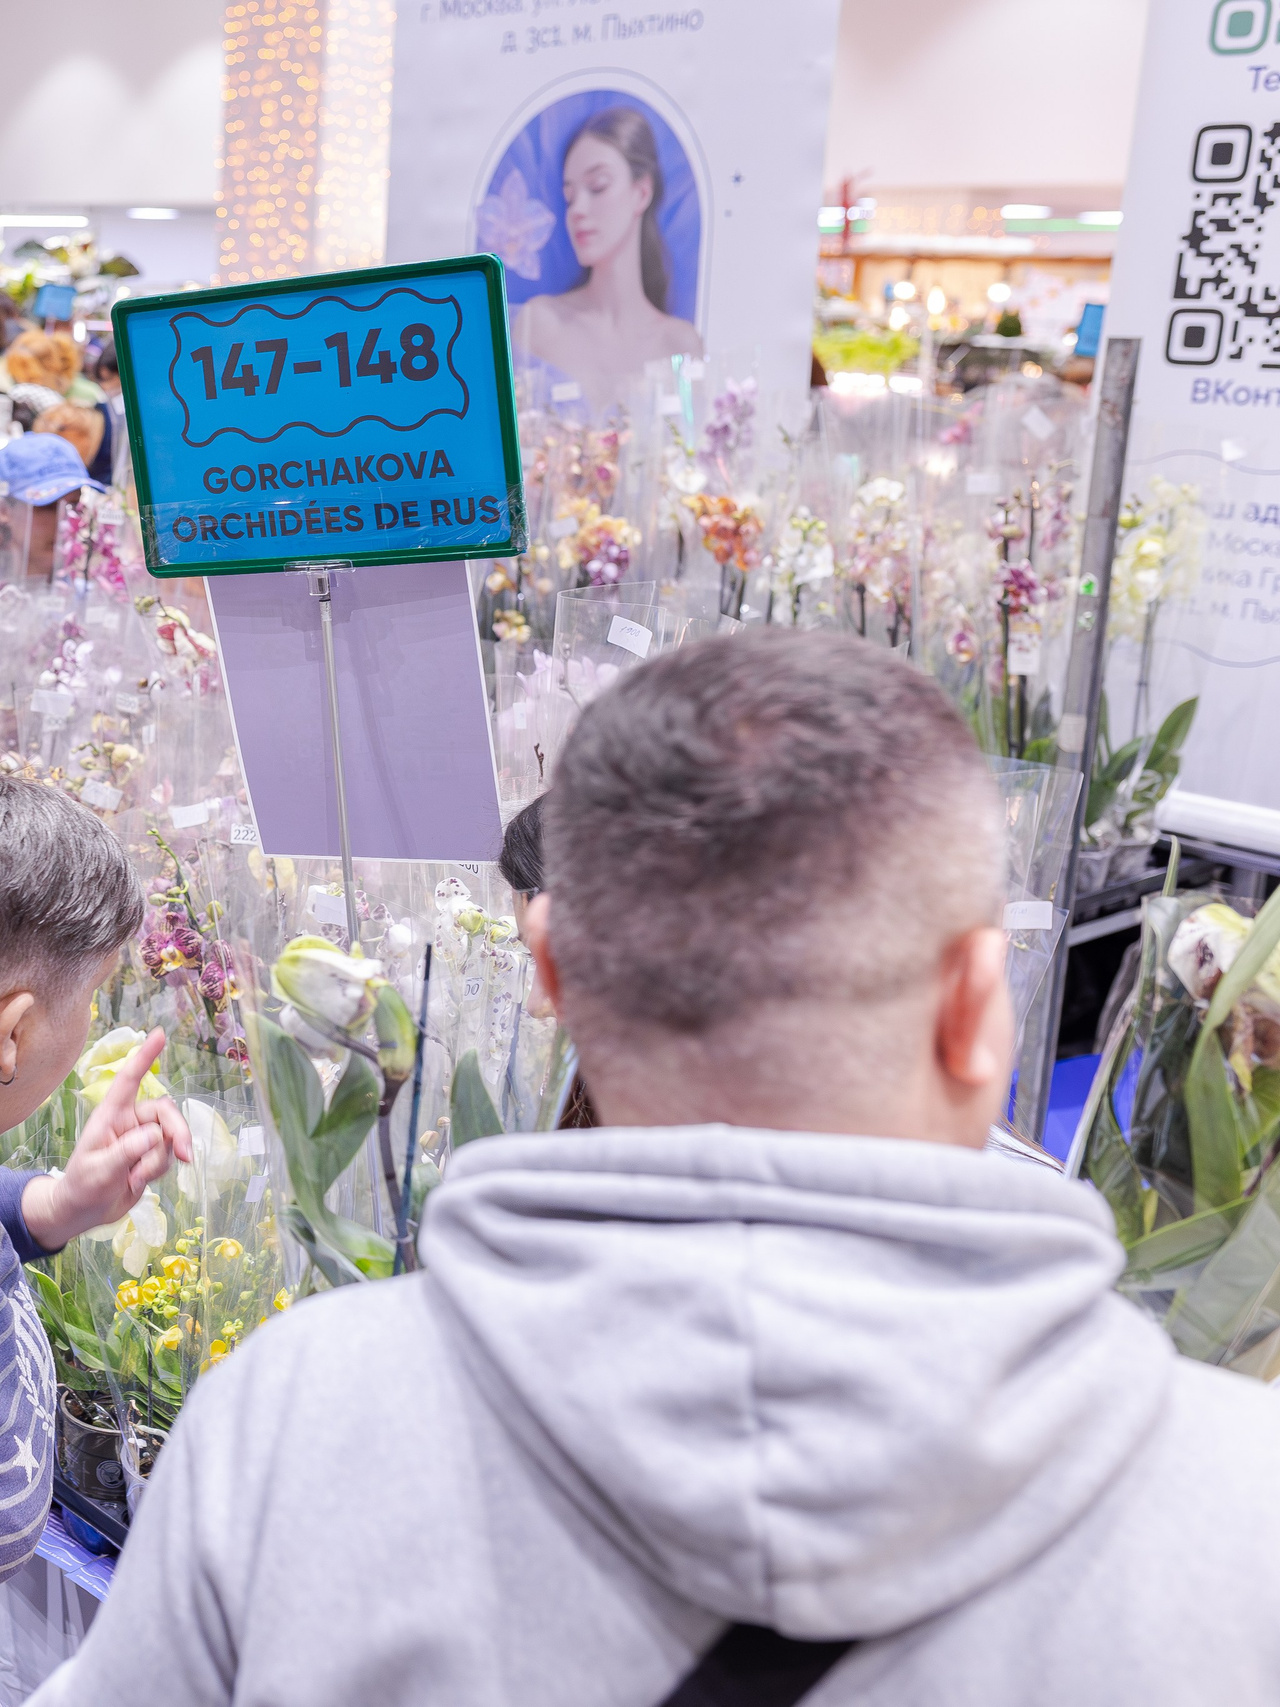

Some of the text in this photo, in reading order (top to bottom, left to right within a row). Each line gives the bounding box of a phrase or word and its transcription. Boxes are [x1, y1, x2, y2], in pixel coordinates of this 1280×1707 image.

[600, 8, 705, 42] Пыхтино
[203, 449, 455, 495] GORCHAKOVA
[172, 495, 501, 542] ORCHIDÉES DE RUS
